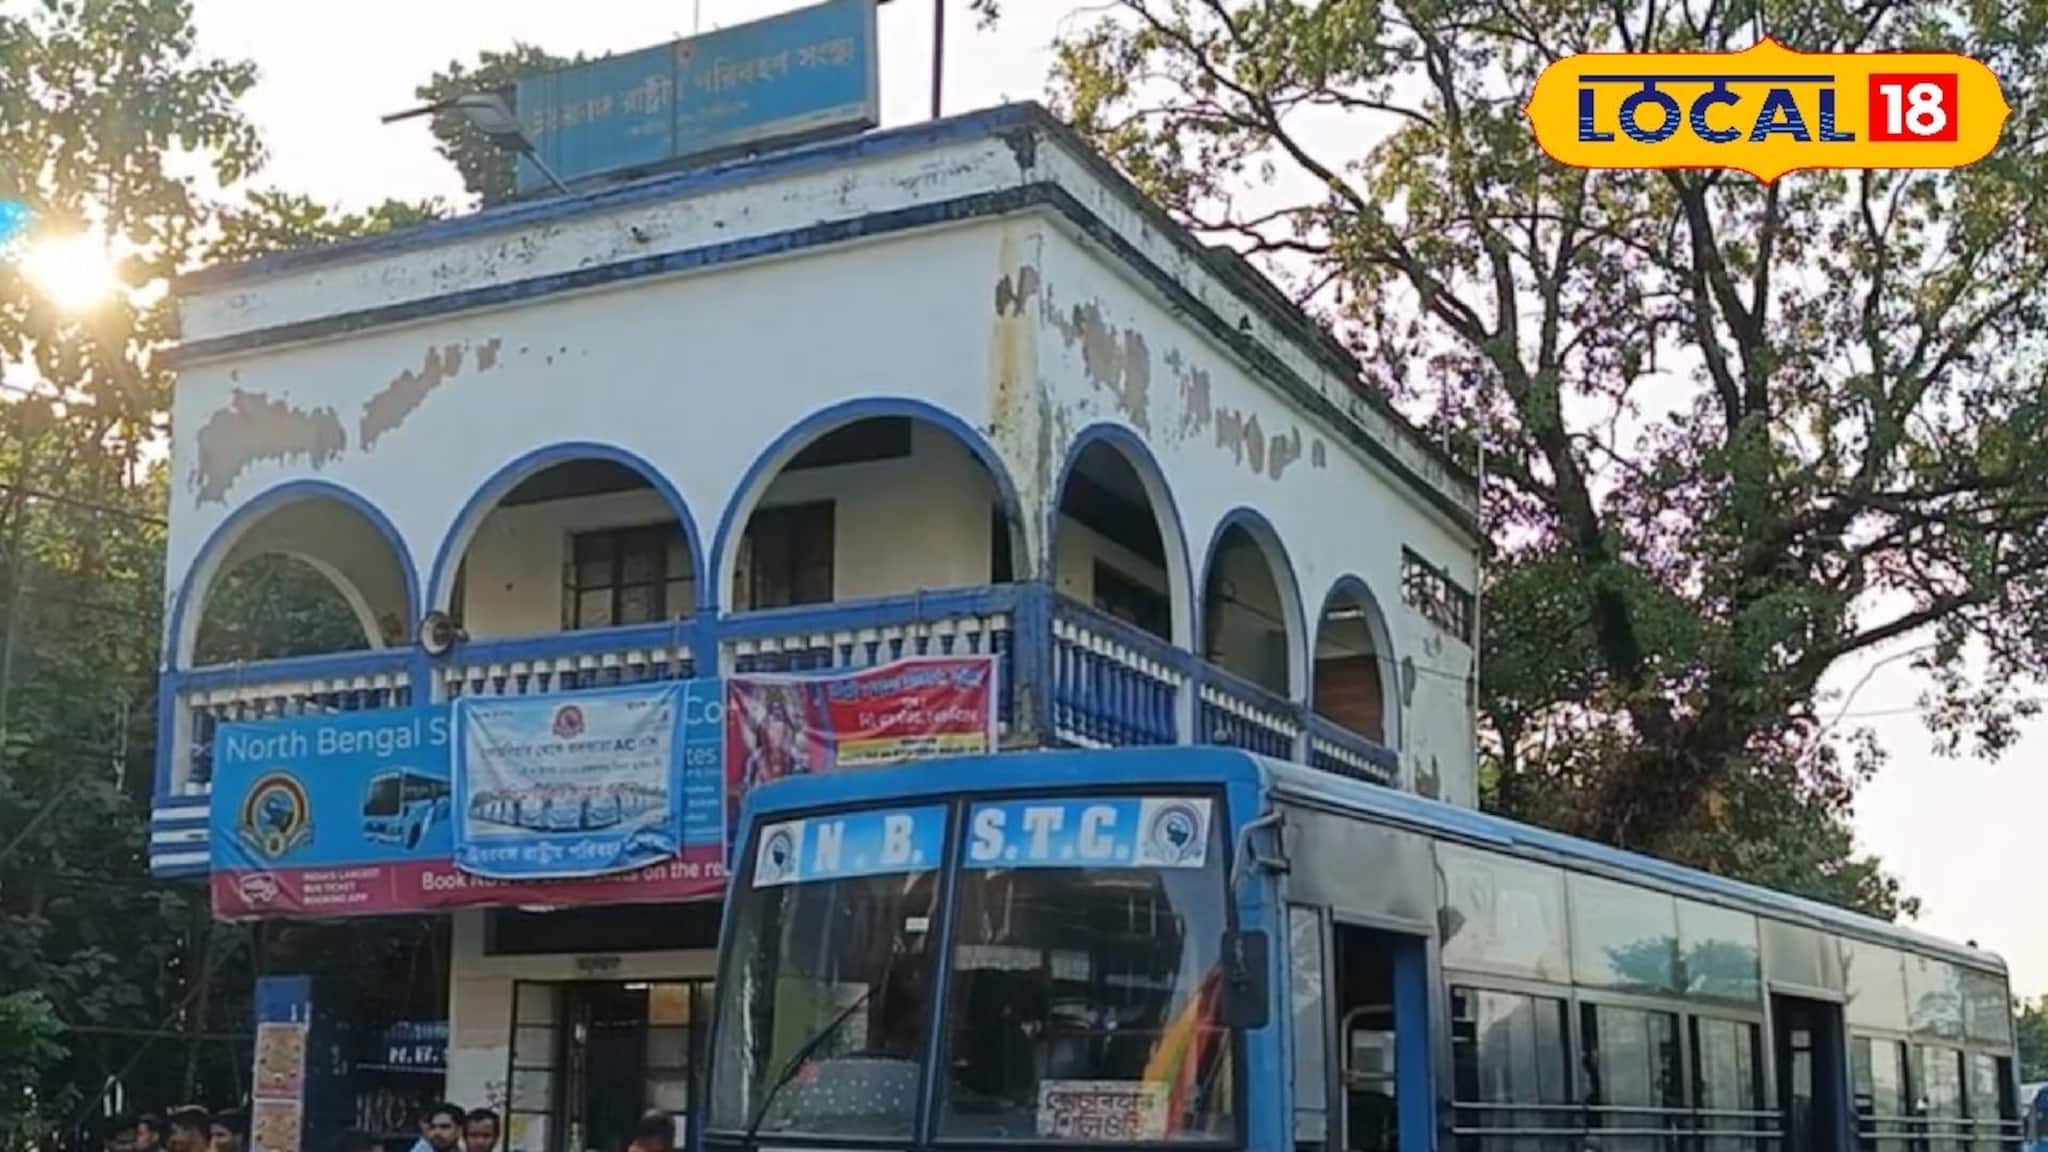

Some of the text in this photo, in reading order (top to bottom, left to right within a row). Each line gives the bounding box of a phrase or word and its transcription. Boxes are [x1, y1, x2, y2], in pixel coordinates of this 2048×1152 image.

[226, 728, 307, 763] North
[317, 718, 421, 757] Bengal
[613, 738, 637, 752] AC
[422, 870, 467, 891] Book
[670, 861, 700, 878] the
